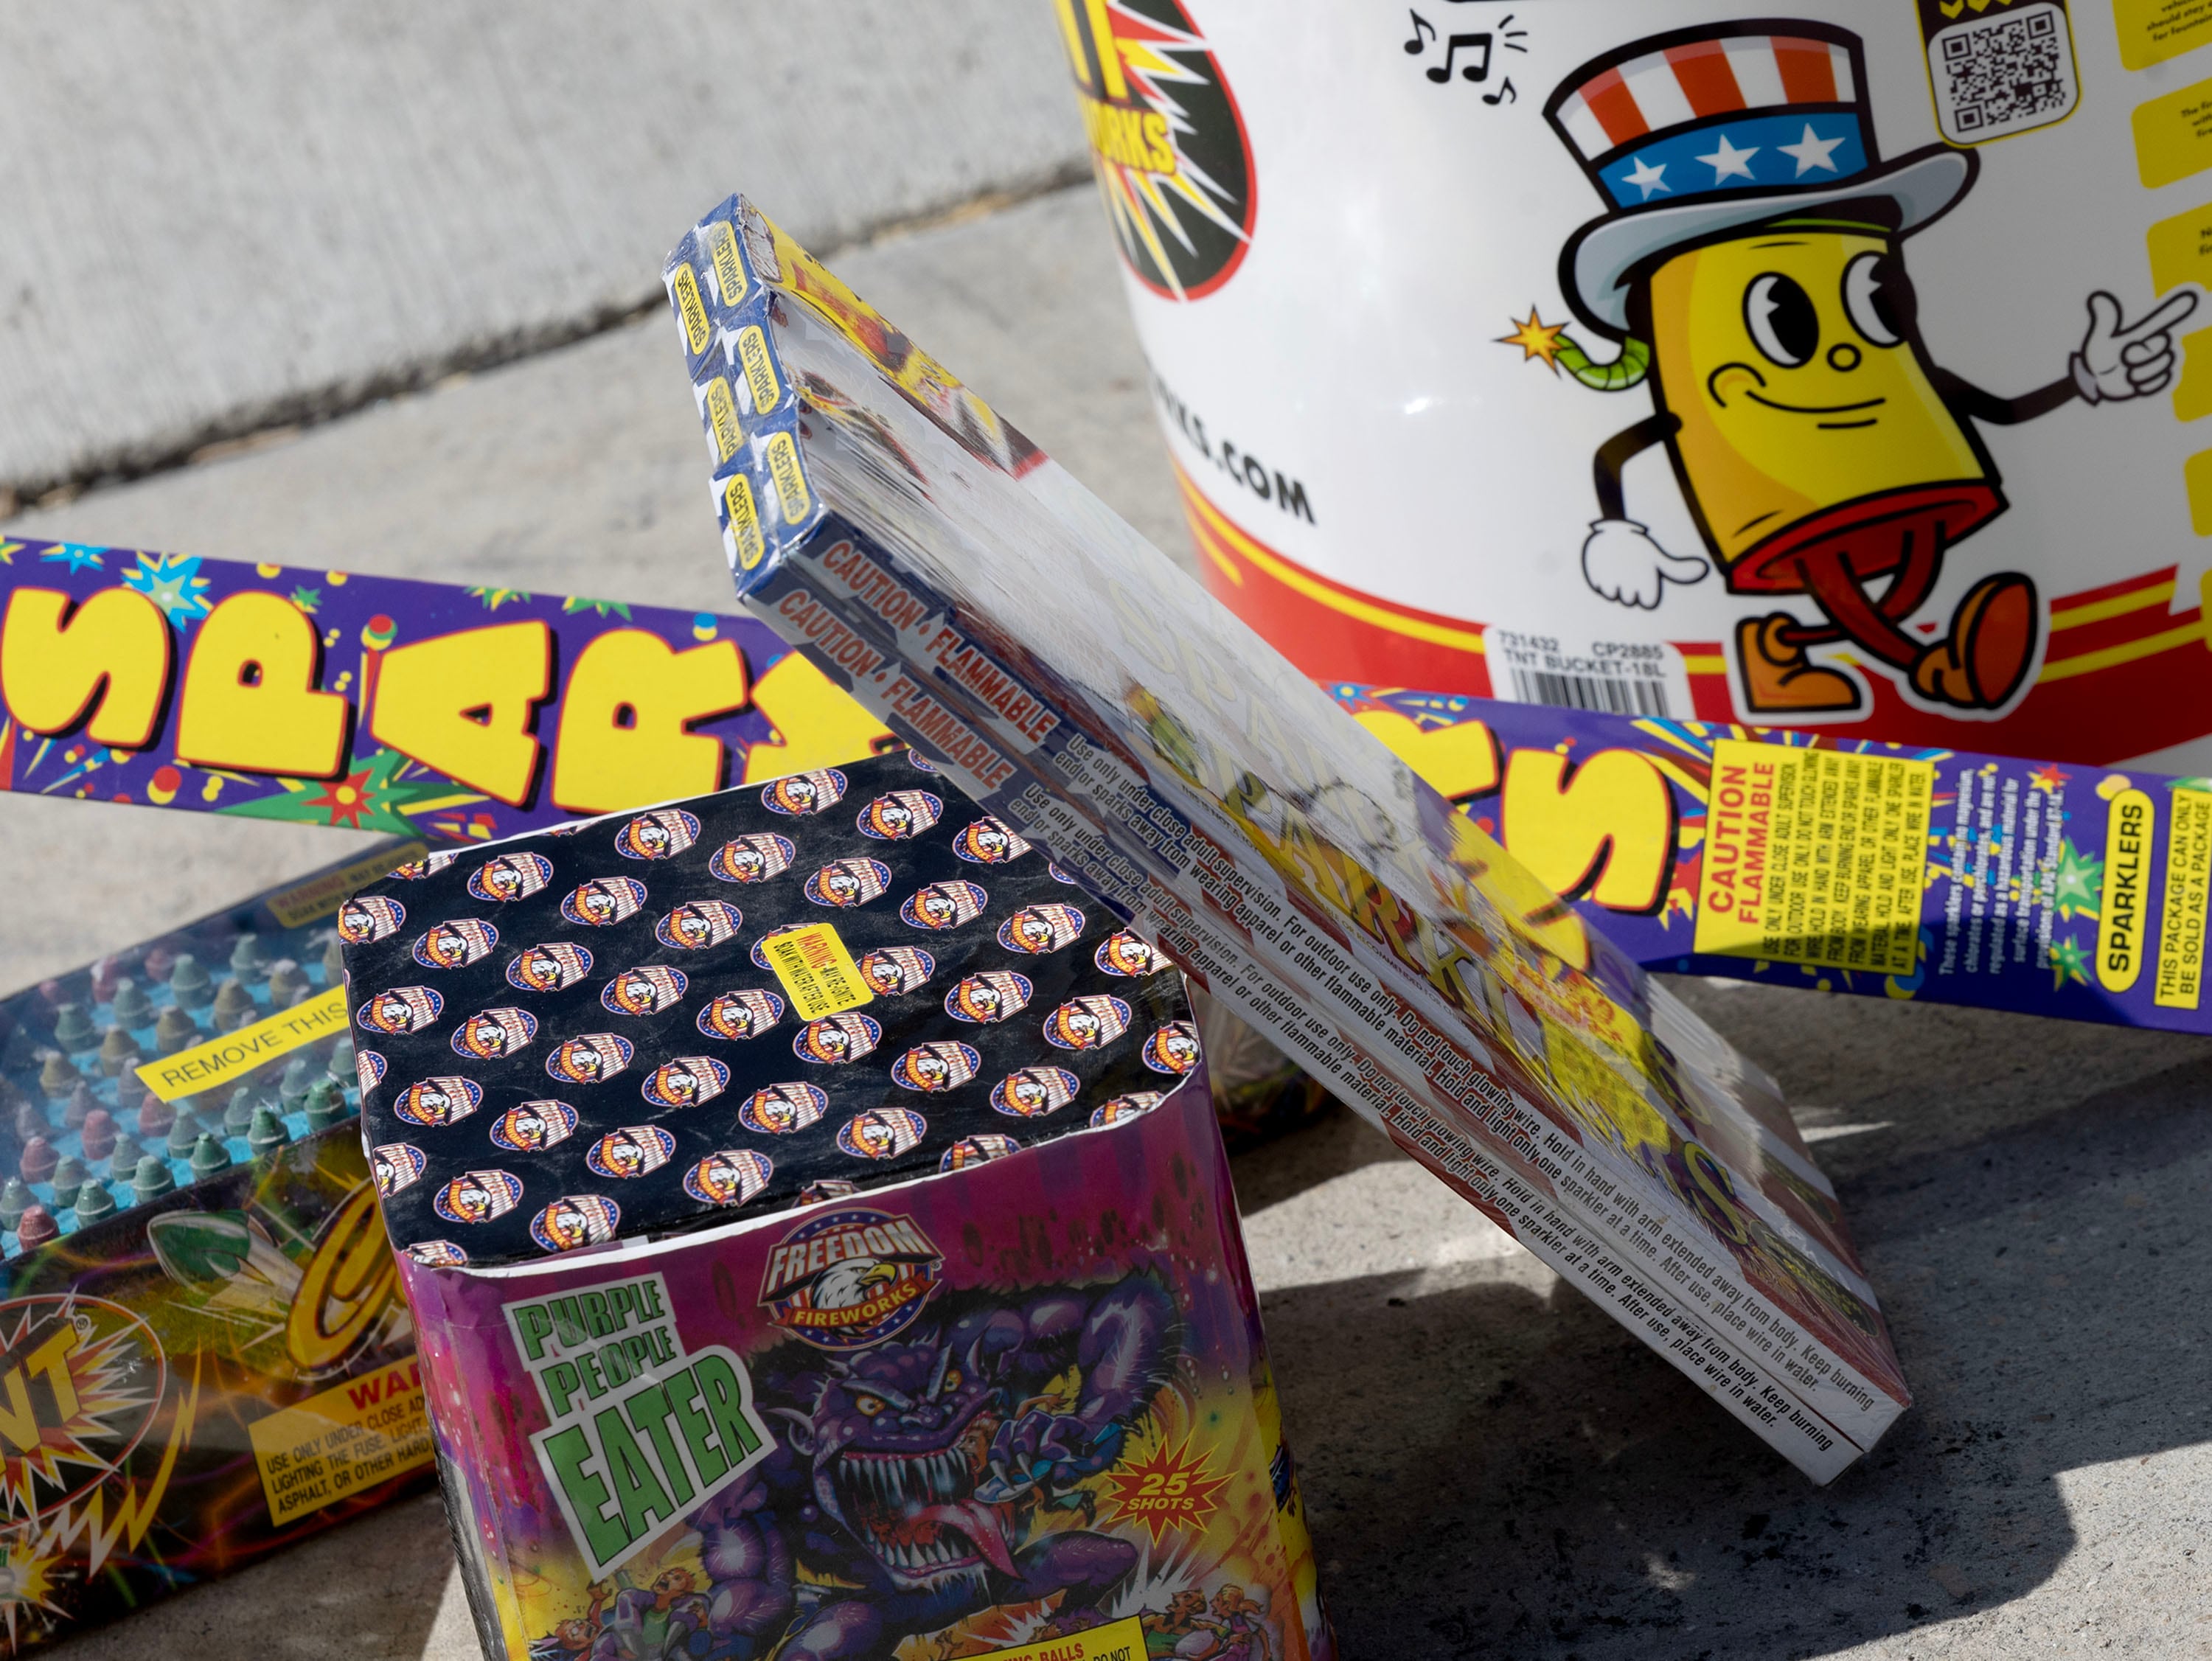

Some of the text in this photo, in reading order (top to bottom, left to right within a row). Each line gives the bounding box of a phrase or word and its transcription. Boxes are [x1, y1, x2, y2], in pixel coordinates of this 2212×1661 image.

[712, 225, 743, 302] SPARKLERS
[678, 268, 707, 349] SPARKLERS
[742, 332, 775, 411] SPARKLERS
[771, 439, 803, 520] SPARKLERS
[730, 481, 759, 563] SPARKLERS
[819, 537, 1060, 744] CAUTION FLAMMABLE
[1504, 649, 1537, 664] TNT
[776, 584, 1013, 795] CAUTION FLAMMABLE
[631, 823, 651, 857] FIREWORKS
[1209, 809, 1230, 829] NOT
[1708, 765, 1747, 913] CAUTION
[1738, 762, 1774, 923] FLAMMABLE
[726, 846, 746, 880] FIREWORKS
[2107, 803, 2143, 972] SPARKLERS
[2159, 793, 2192, 998] THIS PACKAGE CAN ONLY
[2180, 801, 2210, 994] BE SOLD AS A PACKAGE
[1013, 917, 1036, 950] FIREWORKS
[1352, 932, 1424, 992] RECOMMENDED
[160, 999, 348, 1090] REMOVE THIS
[1060, 1010, 1082, 1046] FIREWORKS
[411, 1088, 431, 1123] FIREWORKS
[908, 1054, 931, 1089] FIREWORKS
[1053, 751, 1818, 1393] end or sparks away from wearing apparel or other flammable material. Hold and light only one sparkler at a time. After use, place wire in water.
[1067, 734, 1875, 1413] Use only under close adult supervision. For outdoor use only. Do not touch glowing wire. Hold in hand with arm extended away from body. Keep burning
[507, 1114, 527, 1148] FIREWORKS
[451, 1183, 471, 1220] FIREWORKS
[766, 1219, 932, 1294] FREEDOM
[512, 1280, 665, 1361] PURPLE
[793, 1281, 917, 1326] FIREWORKS
[540, 1325, 676, 1418] PEOPLE
[265, 1452, 290, 1474] USE
[291, 1438, 323, 1463] ONLY
[324, 1420, 365, 1449] UNDER
[366, 1402, 406, 1431] CLOSE
[270, 1459, 324, 1494] LIGHTING
[326, 1448, 350, 1469] THE
[388, 1417, 425, 1444] LIGHT
[543, 1354, 763, 1568] EATER
[275, 1478, 332, 1514] ASPHALT,
[332, 1469, 353, 1489] OR
[352, 1452, 394, 1480] OTHER
[1128, 1497, 1194, 1511] SHOTS
[1138, 1474, 1193, 1496] 25
